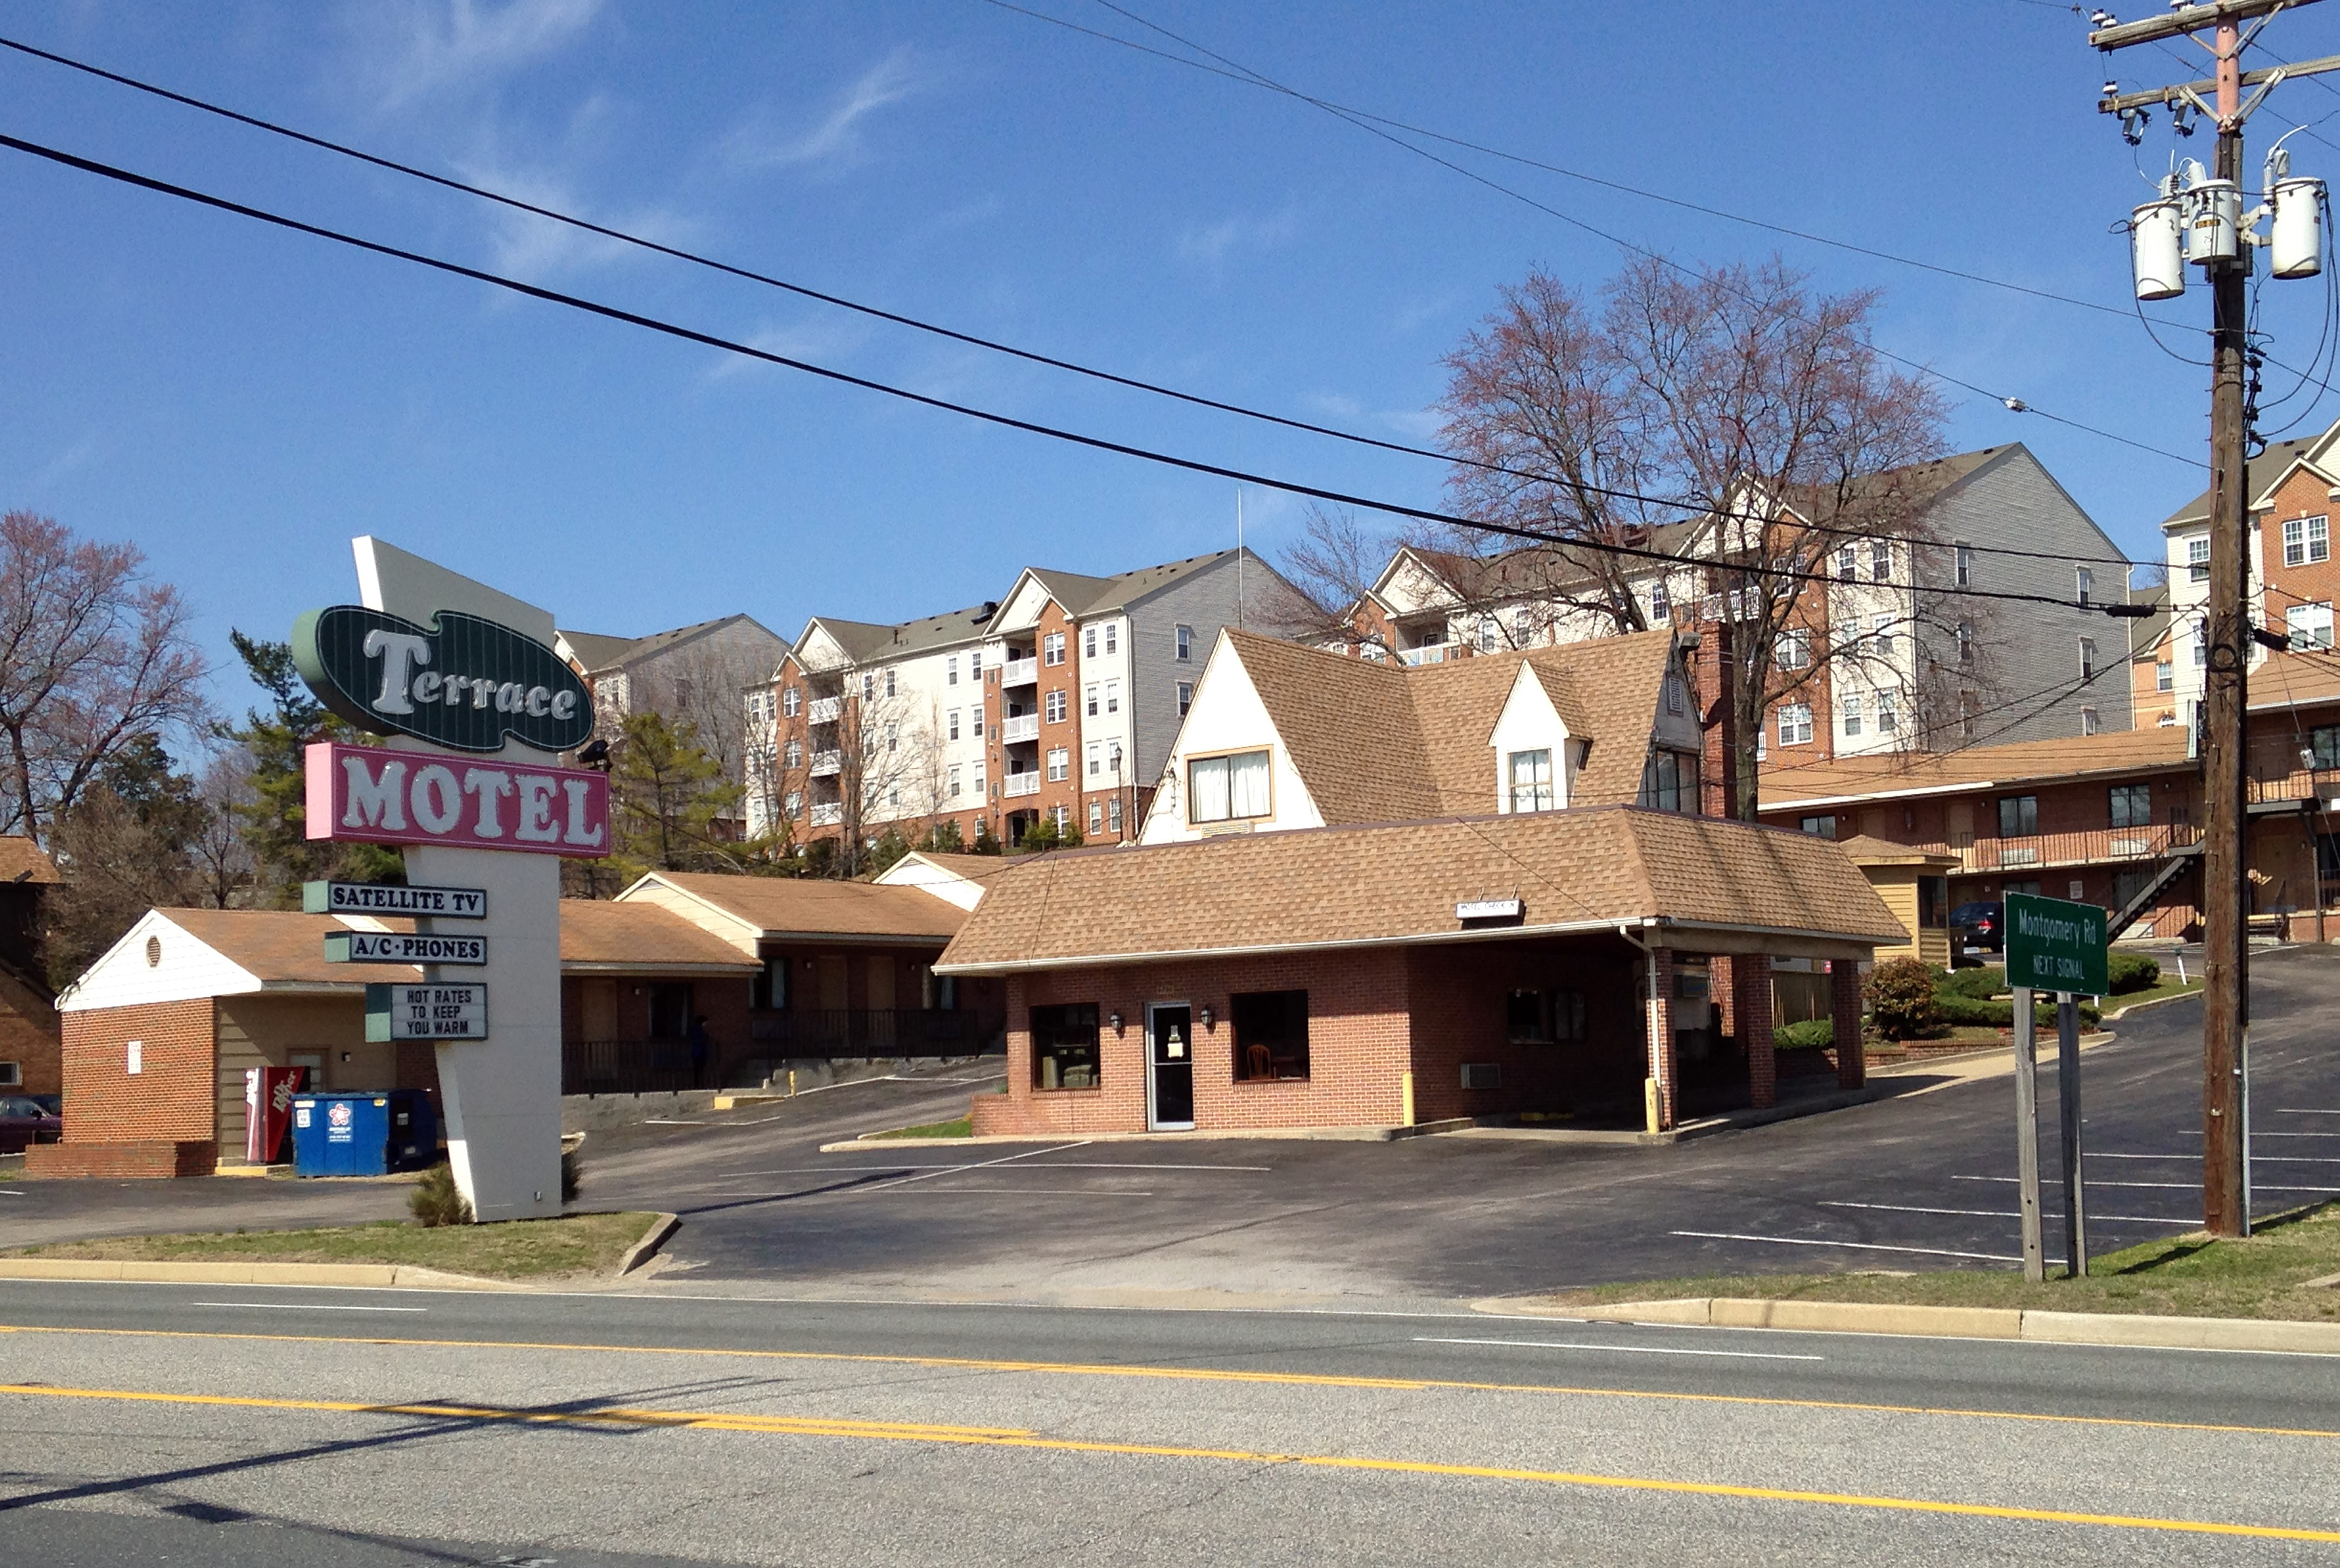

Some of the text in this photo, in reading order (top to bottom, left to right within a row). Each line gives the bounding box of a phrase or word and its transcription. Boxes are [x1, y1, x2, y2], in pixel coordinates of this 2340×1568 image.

[363, 628, 577, 721] Terrace
[341, 756, 605, 847] MOTEL
[334, 887, 479, 911] SATELLITE TV
[2019, 908, 2097, 949] Montgomery Rd
[402, 939, 480, 959] PHONES
[2034, 954, 2085, 979] NEXT SIGNAL
[407, 990, 471, 1004] HOT RATES
[411, 1006, 460, 1018] TO KEEP
[407, 1021, 468, 1034] YOU WARM
